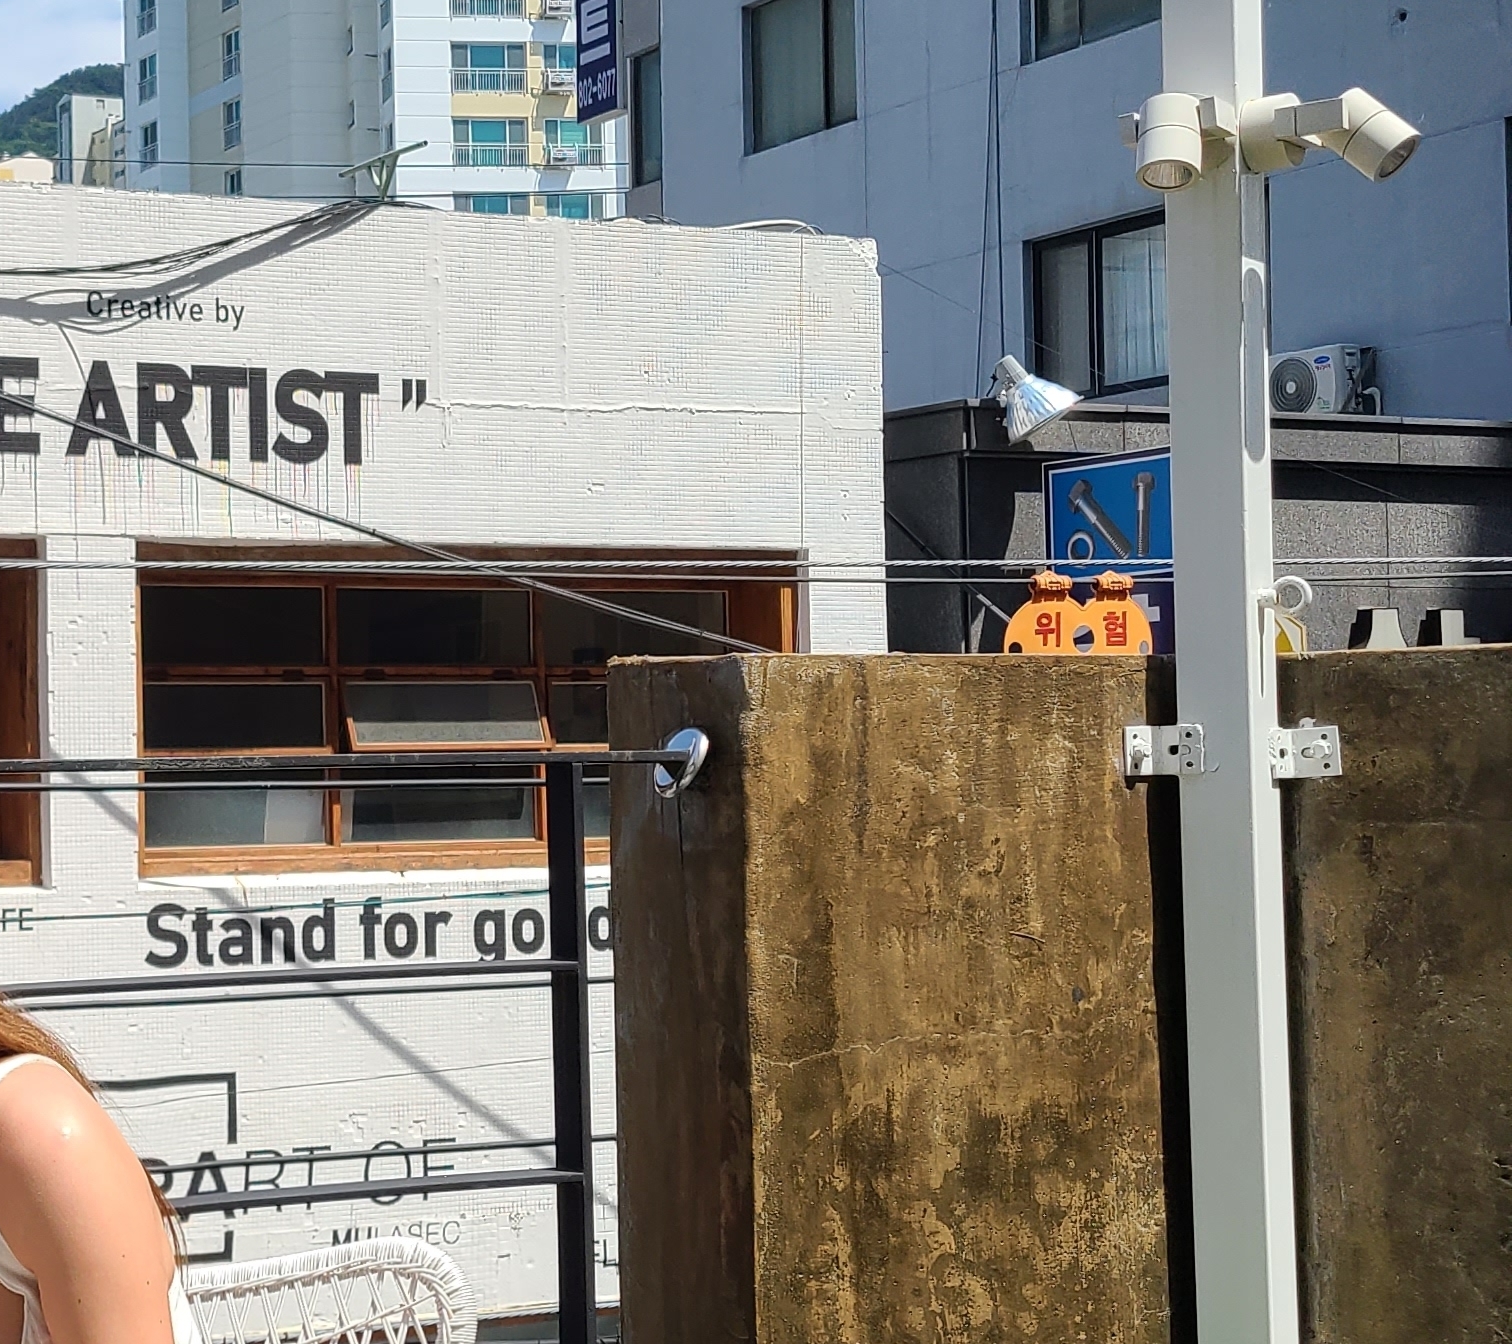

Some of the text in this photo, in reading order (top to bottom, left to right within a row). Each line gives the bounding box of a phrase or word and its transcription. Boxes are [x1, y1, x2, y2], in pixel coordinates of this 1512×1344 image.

[578, 67, 616, 109] 802-6077
[86, 290, 246, 331] Creative by
[65, 360, 380, 465] ARTIST
[1034, 610, 1128, 648] 위험
[144, 889, 613, 969] Stand for god
[364, 1137, 456, 1205] OF
